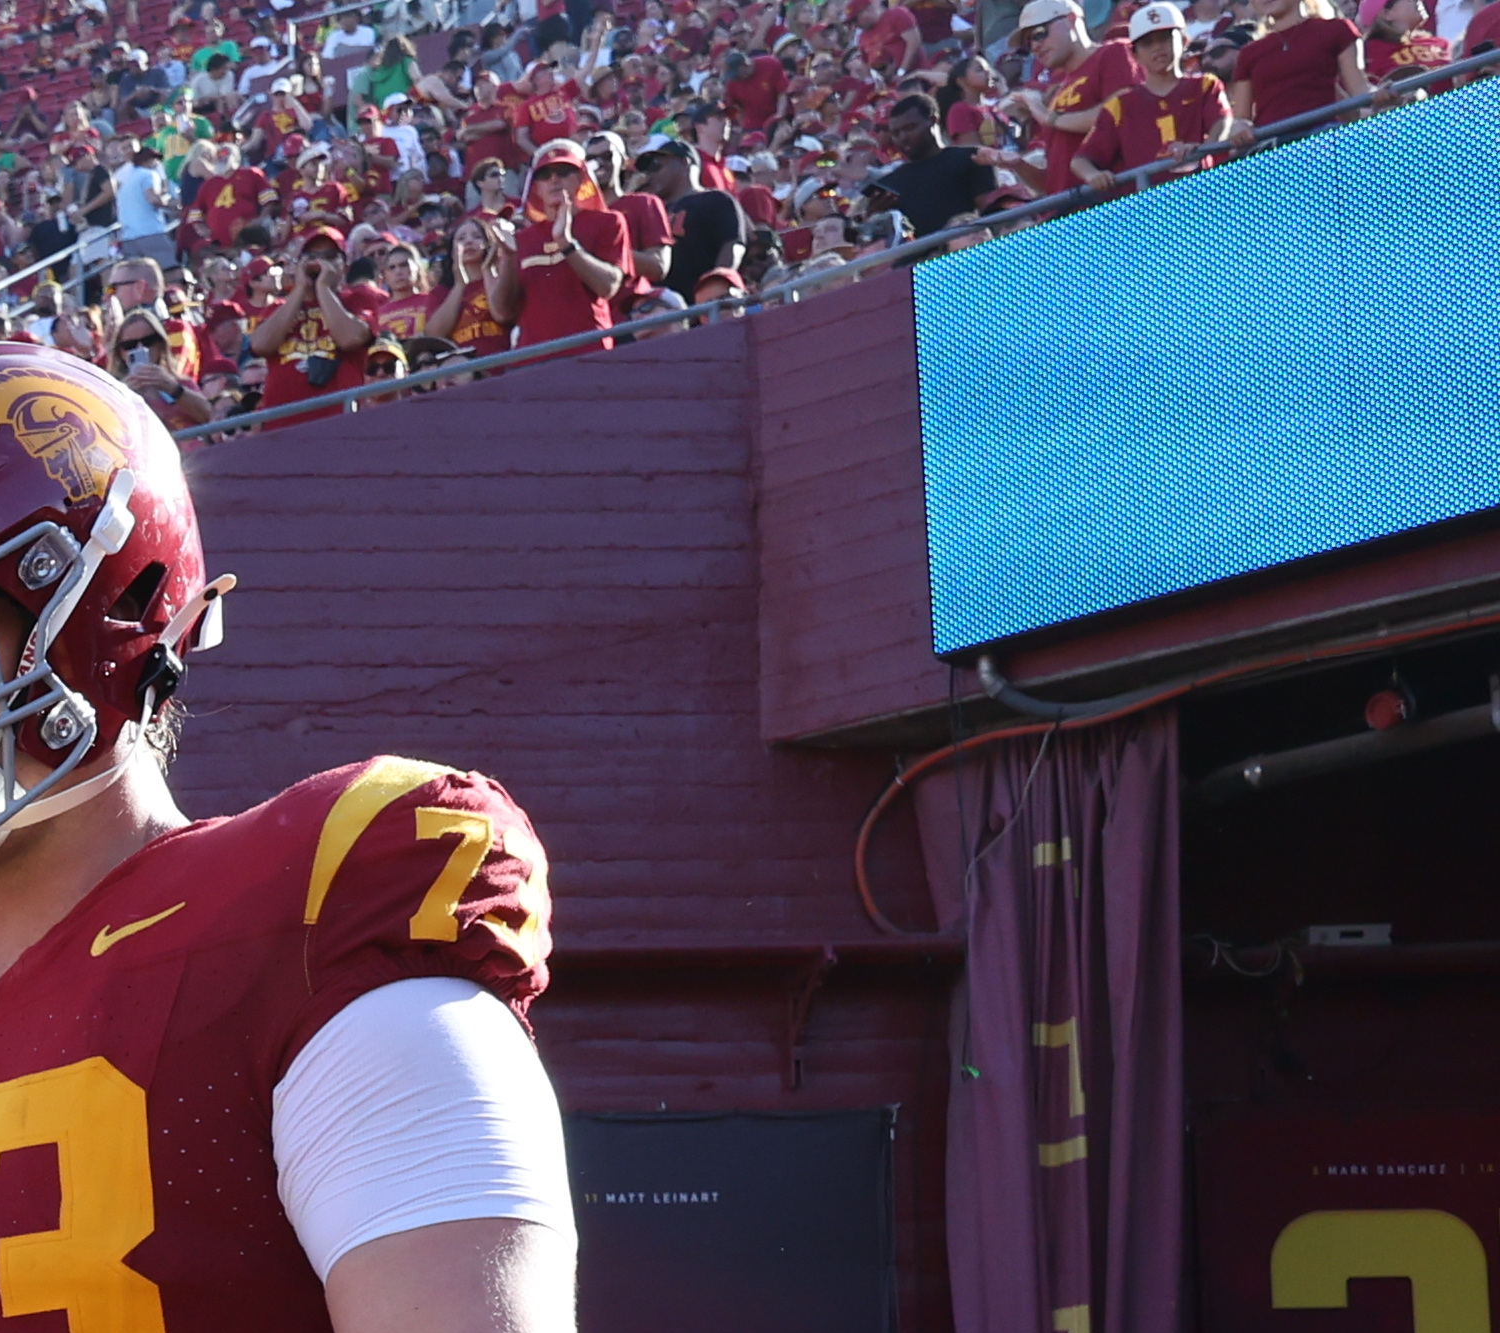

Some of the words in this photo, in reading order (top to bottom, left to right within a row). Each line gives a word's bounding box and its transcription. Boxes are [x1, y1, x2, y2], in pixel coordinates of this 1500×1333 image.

[213, 184, 236, 208] 4
[1327, 1163, 1368, 1175] MARK
[1377, 1163, 1447, 1175] SANCHEZ
[605, 1192, 643, 1203] MATT
[651, 1191, 720, 1203] LEINART
